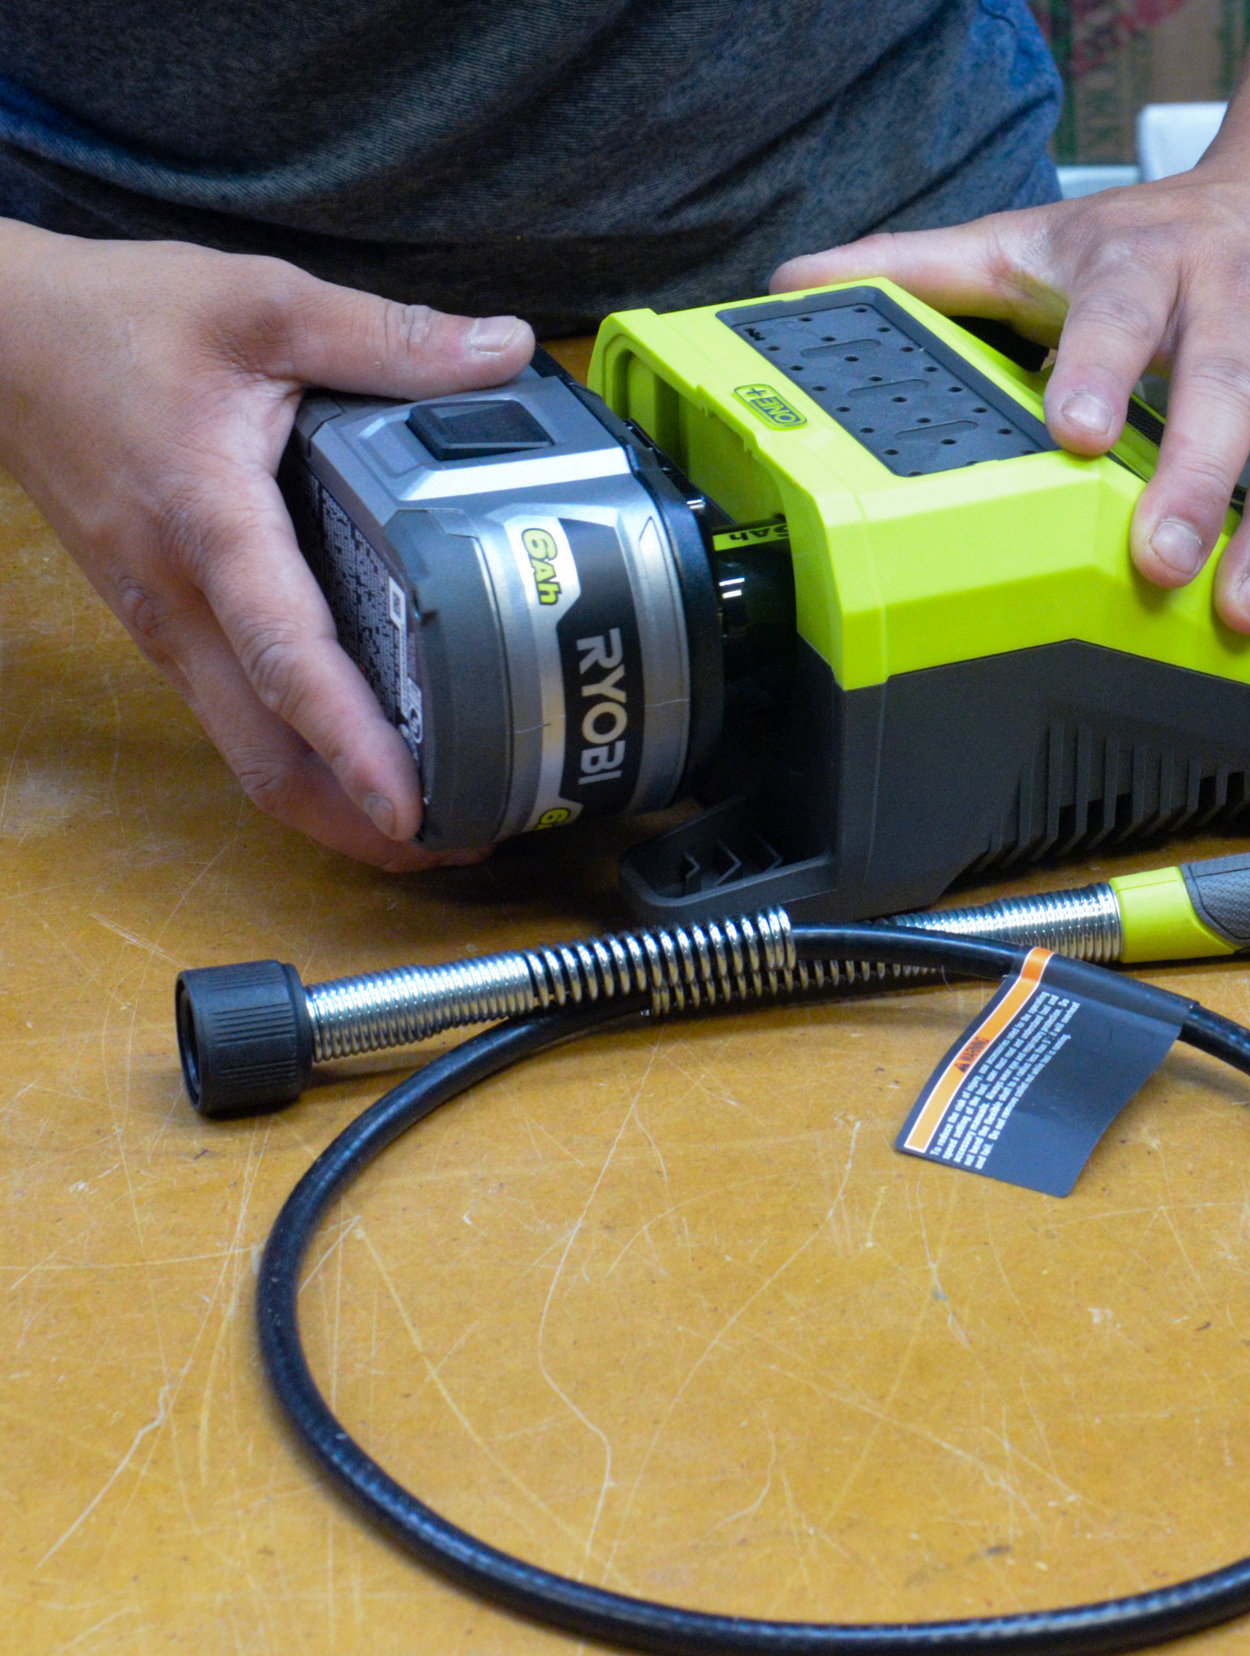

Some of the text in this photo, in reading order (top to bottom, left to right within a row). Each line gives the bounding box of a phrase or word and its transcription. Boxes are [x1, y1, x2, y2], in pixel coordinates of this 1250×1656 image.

[521, 527, 562, 606] 6Ah
[576, 627, 628, 785] RYOBI
[936, 1123, 954, 1147] reduce
[947, 1111, 960, 1124] the
[954, 1098, 967, 1112] risk
[942, 1138, 959, 1160] speed
[952, 1115, 972, 1139] setting
[975, 1125, 991, 1138] the
[951, 1129, 977, 1164] accessory
[968, 1135, 984, 1155] bend
[974, 1155, 987, 1170] and
